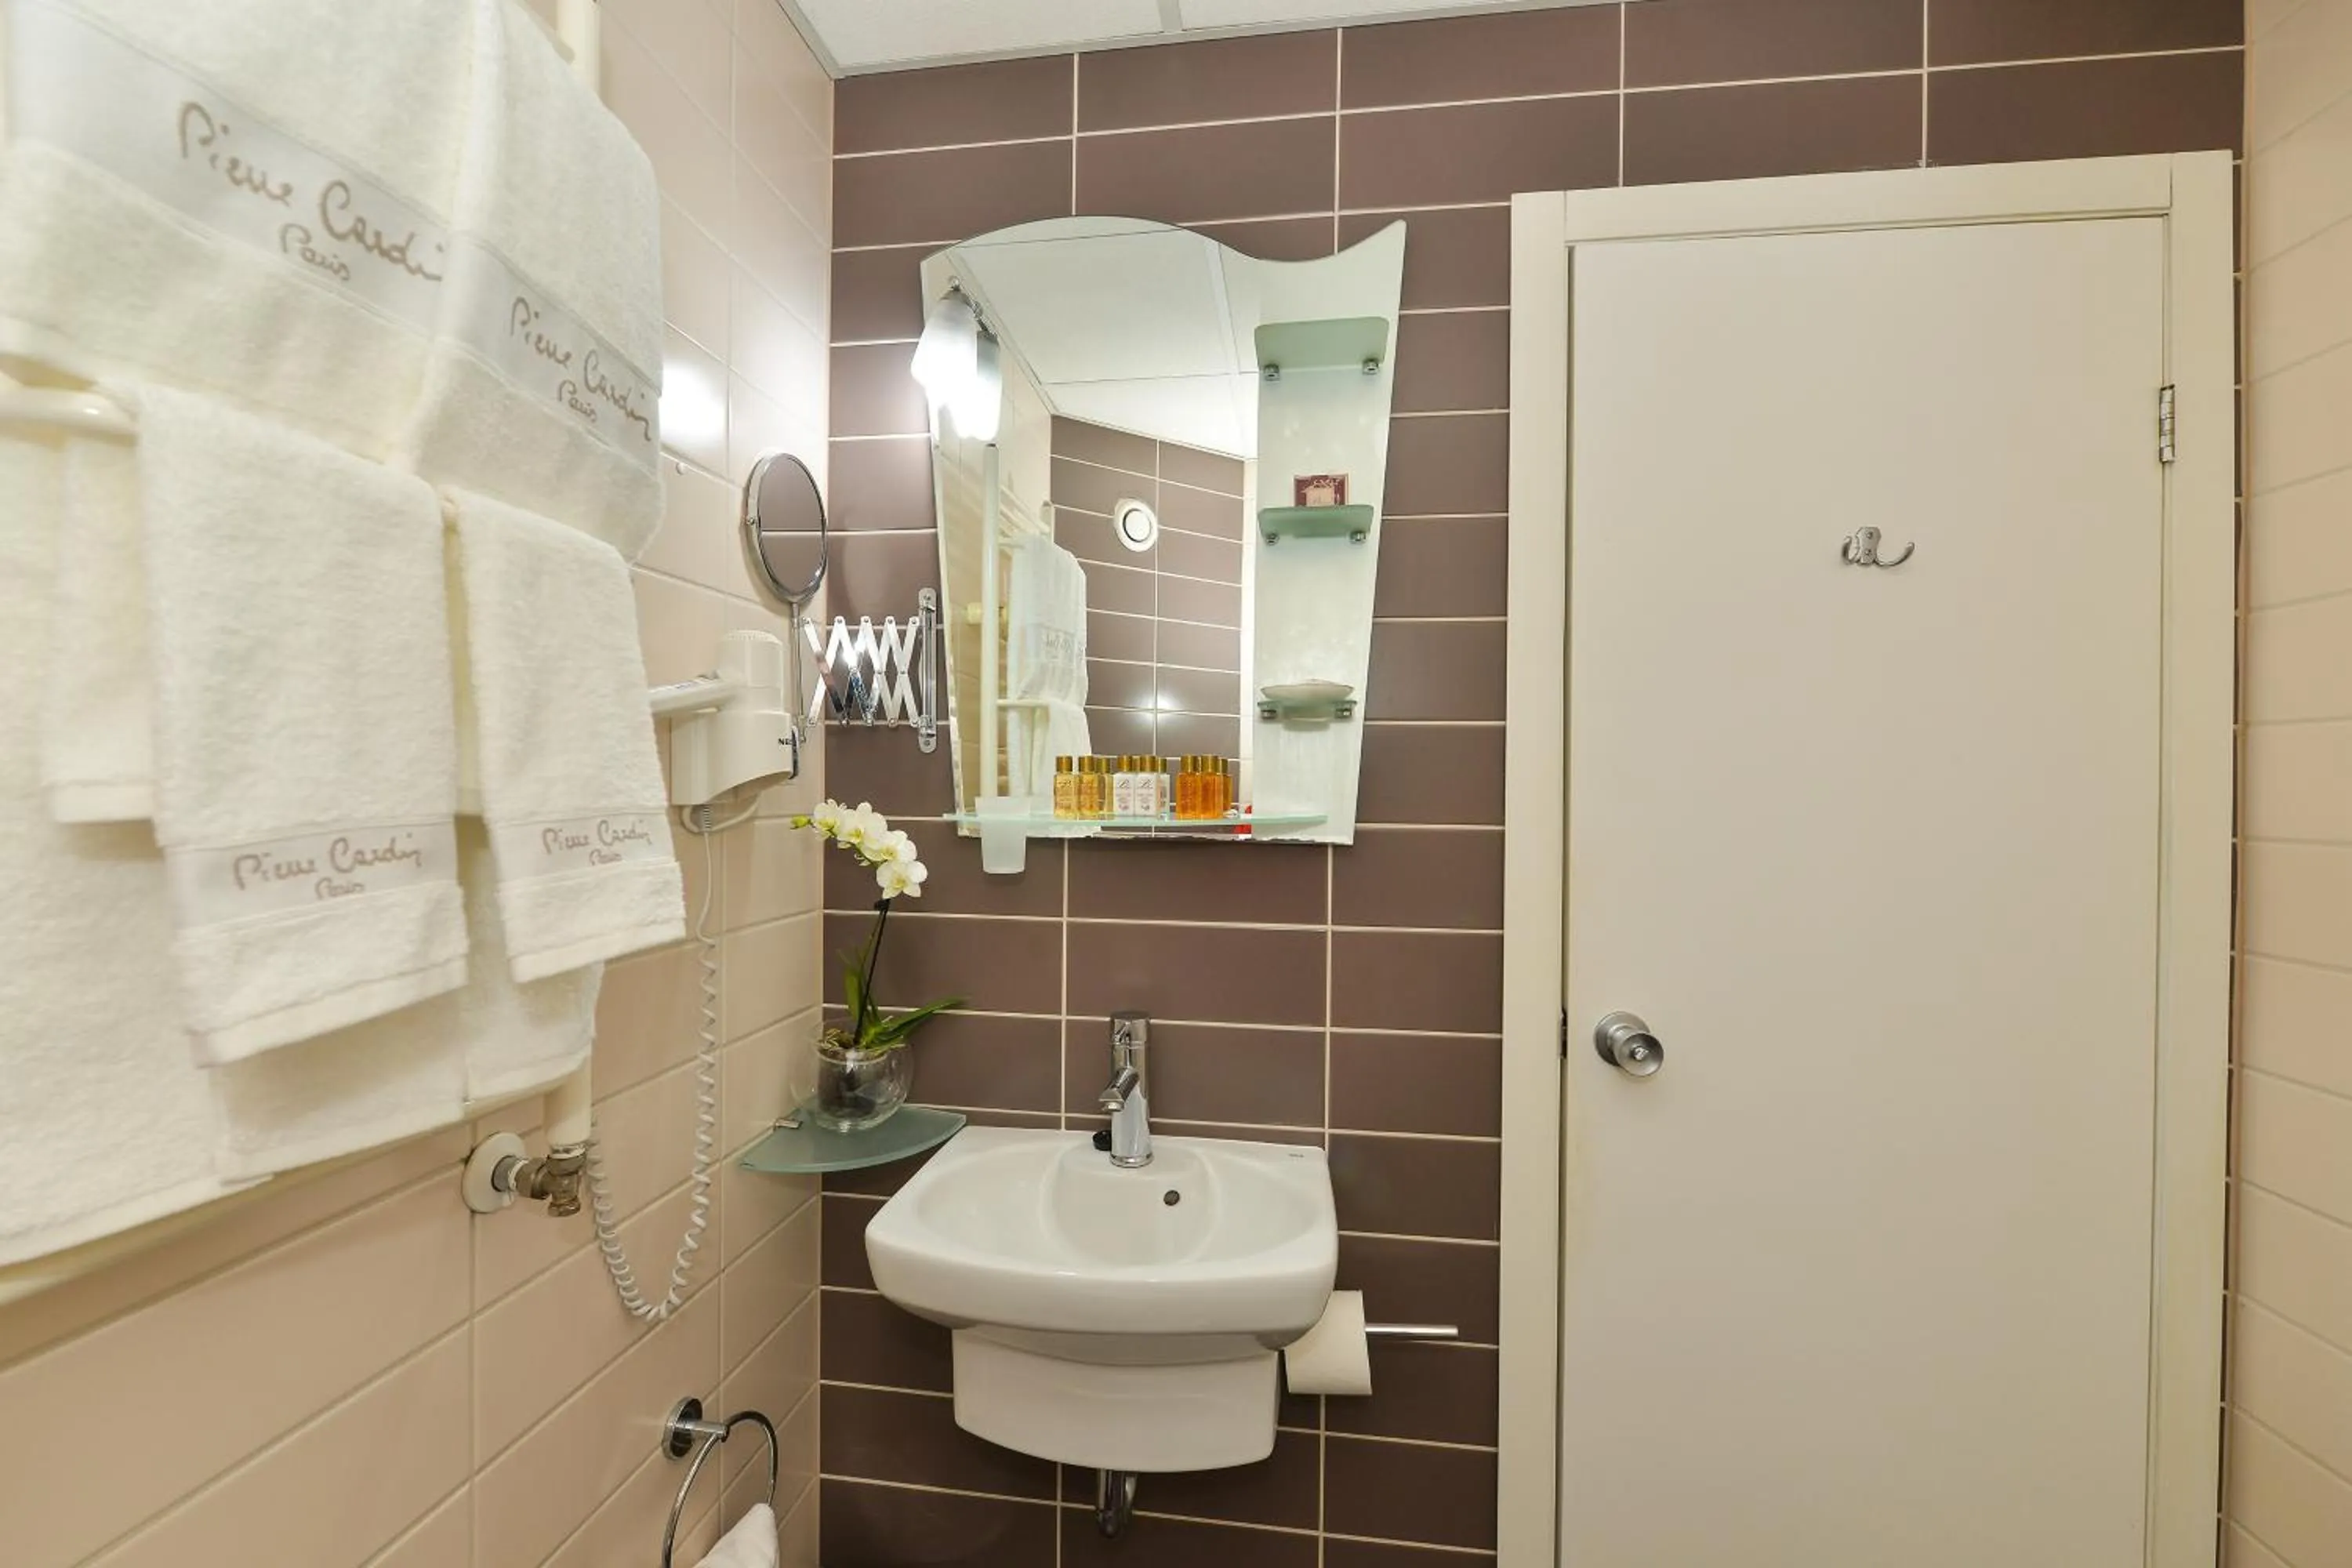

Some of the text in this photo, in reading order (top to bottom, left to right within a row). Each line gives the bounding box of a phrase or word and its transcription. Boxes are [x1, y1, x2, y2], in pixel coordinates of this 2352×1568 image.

[278, 223, 350, 281] Paris
[557, 379, 597, 423] Paris
[583, 348, 652, 442] Cardin
[328, 833, 422, 873] Cardin
[597, 818, 653, 847] Cardin
